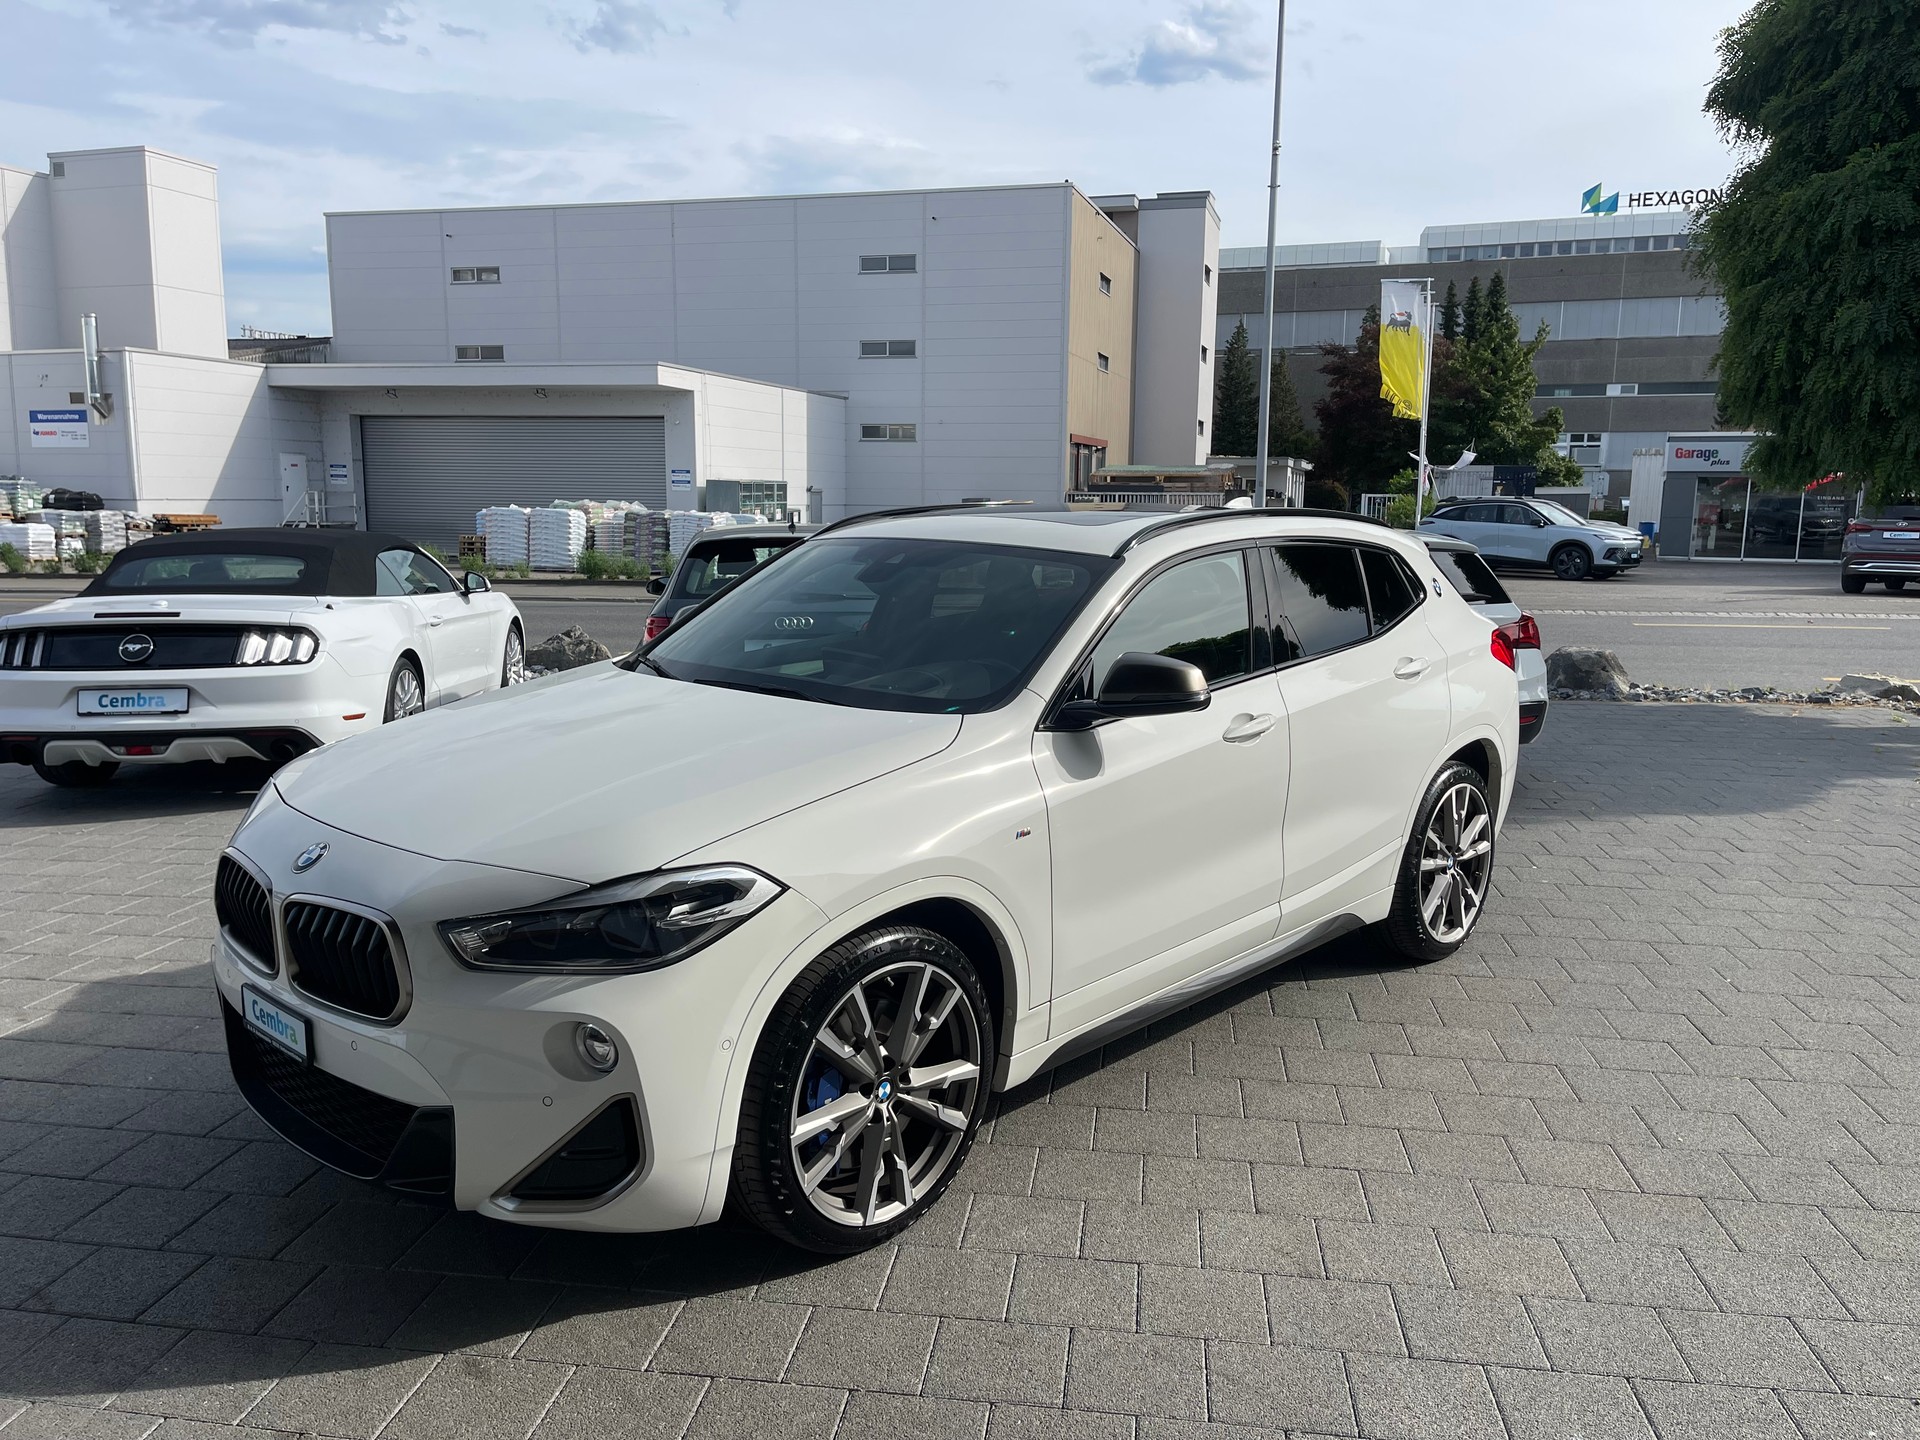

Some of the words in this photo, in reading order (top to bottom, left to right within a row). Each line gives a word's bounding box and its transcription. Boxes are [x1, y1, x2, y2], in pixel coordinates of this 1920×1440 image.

[1628, 188, 1724, 208] HEXAGON
[37, 413, 80, 421] Warenannahme
[1675, 447, 1719, 462] Garage
[98, 692, 166, 708] Cembra
[252, 999, 298, 1045] Cembra
